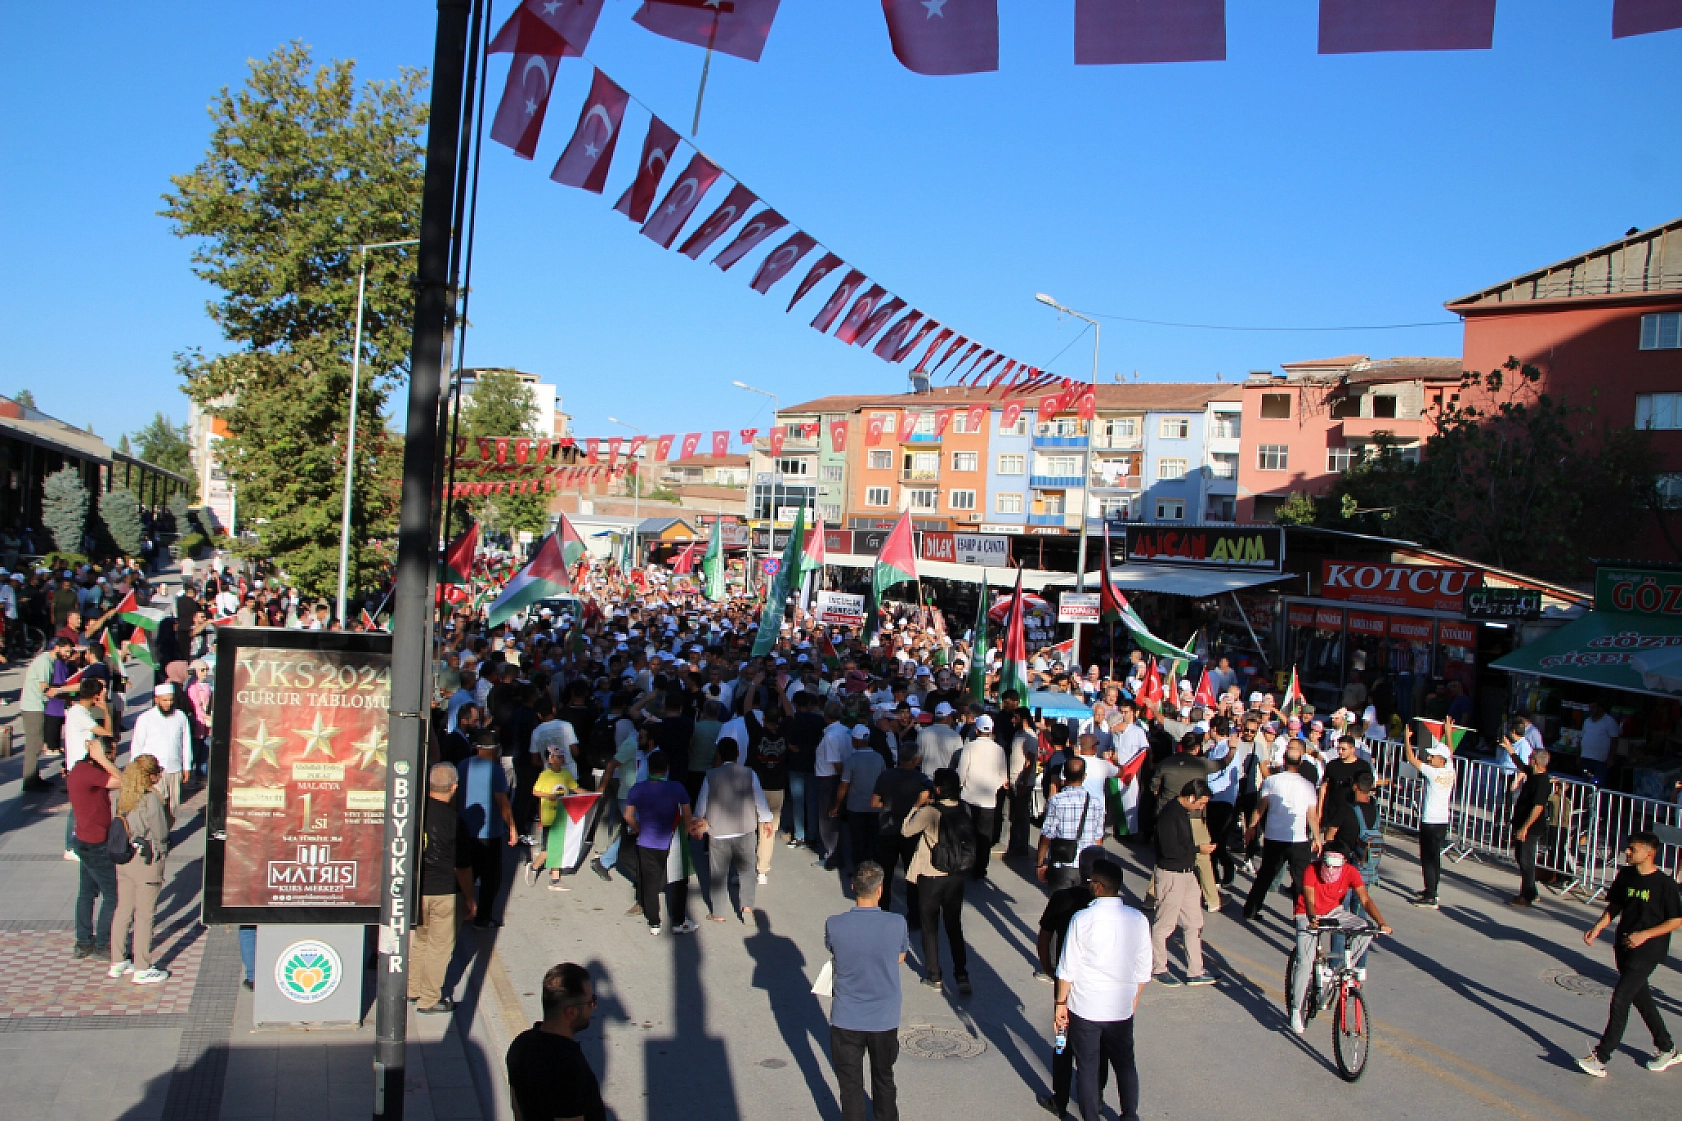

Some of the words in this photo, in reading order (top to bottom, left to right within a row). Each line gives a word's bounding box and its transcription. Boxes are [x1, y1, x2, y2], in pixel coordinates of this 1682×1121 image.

[1211, 533, 1266, 564] AVM
[1324, 564, 1476, 597] KOTCU
[1612, 577, 1682, 614] GÖZ
[241, 660, 315, 689] YKS
[318, 663, 392, 693] 2024
[236, 690, 302, 706] GURUR
[297, 781, 341, 791] MALATYA
[272, 865, 353, 884] MATRIS
